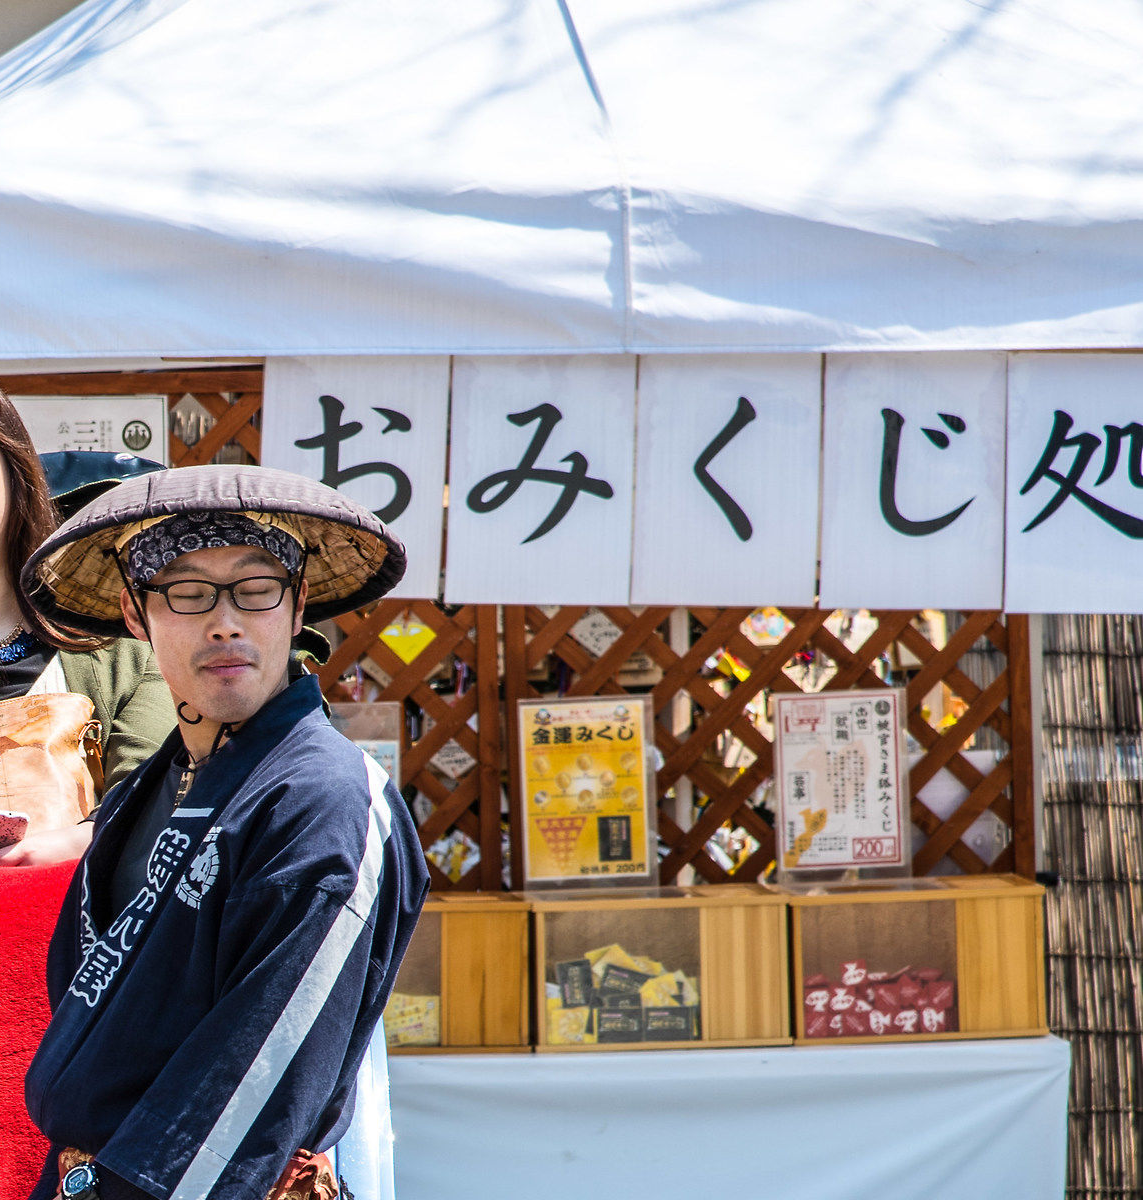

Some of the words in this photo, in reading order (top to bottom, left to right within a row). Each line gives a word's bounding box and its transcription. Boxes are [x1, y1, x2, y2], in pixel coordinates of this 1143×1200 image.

[294, 395, 1143, 545] おみくじ処
[855, 706, 869, 730] 出世
[531, 723, 635, 745] 金運みくじ
